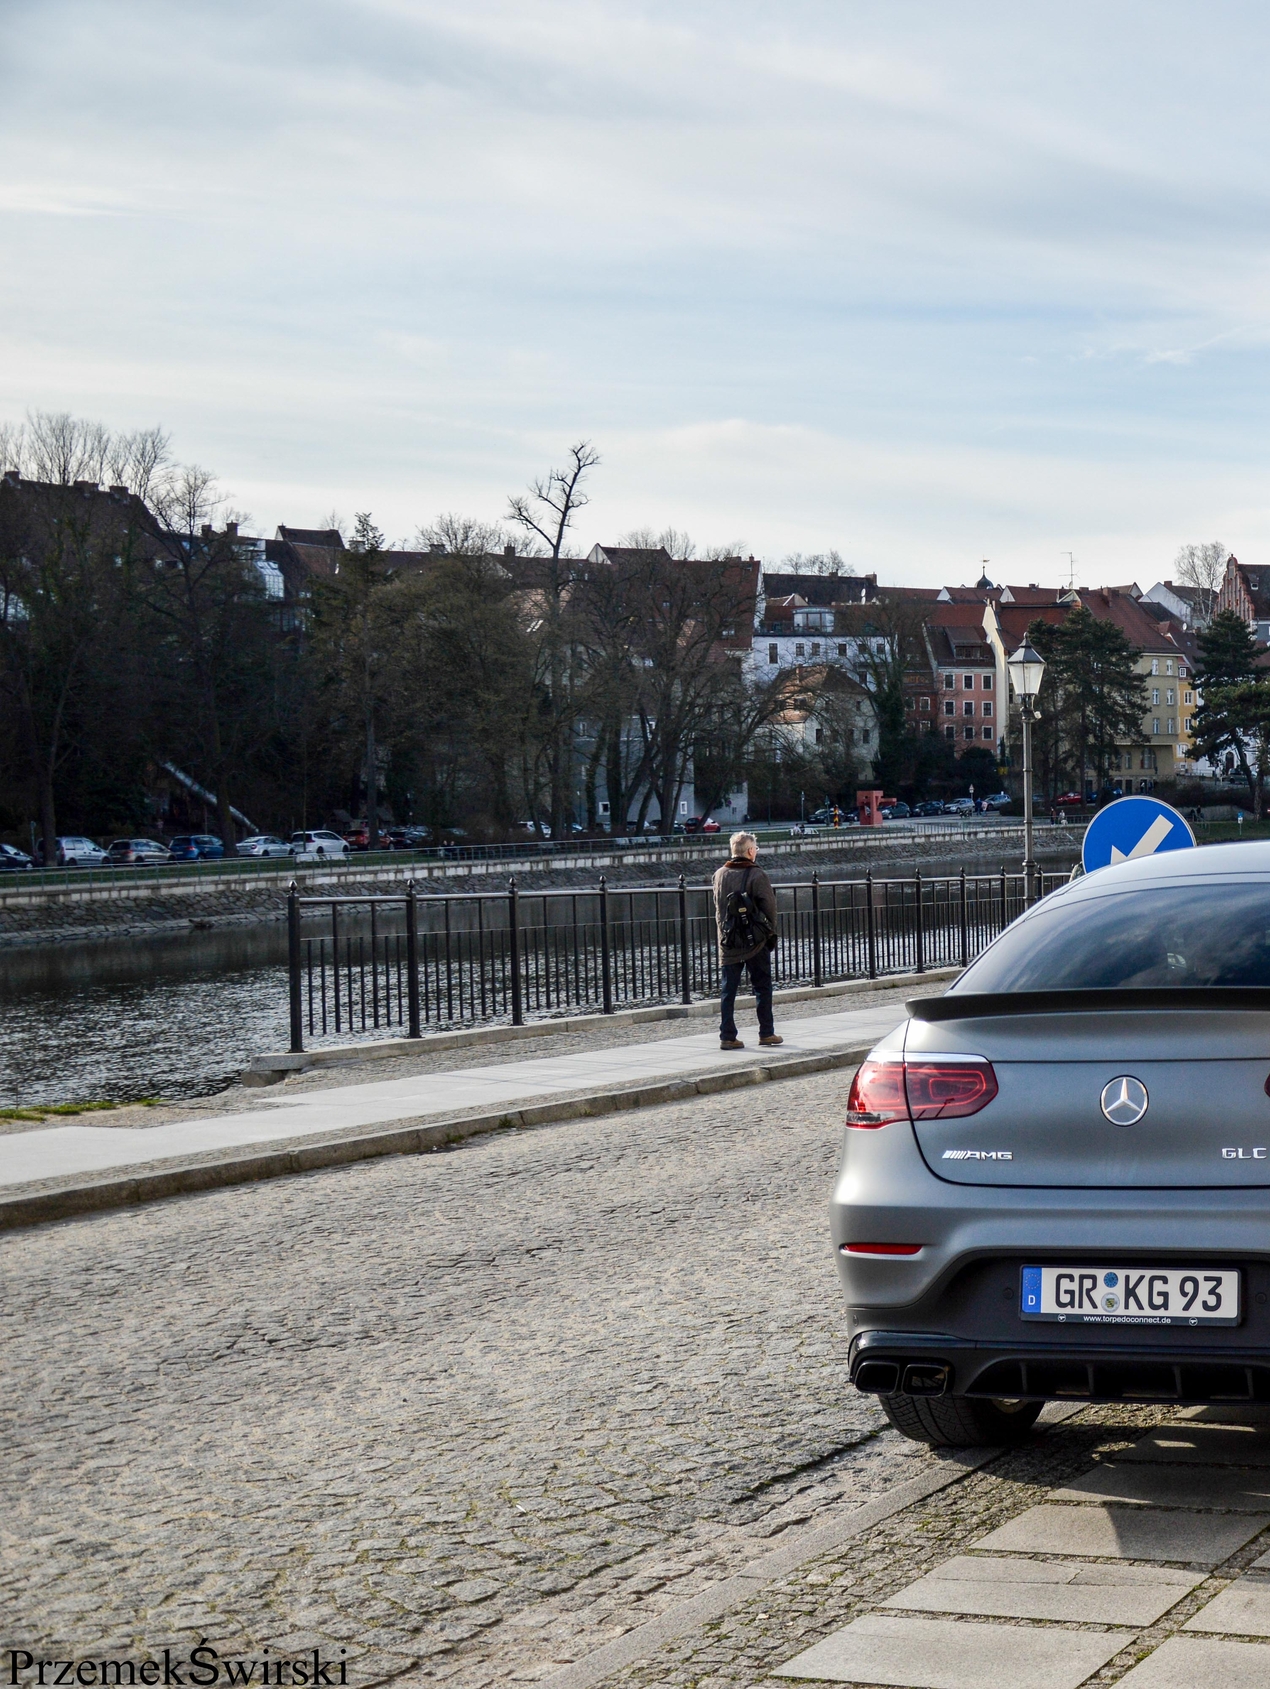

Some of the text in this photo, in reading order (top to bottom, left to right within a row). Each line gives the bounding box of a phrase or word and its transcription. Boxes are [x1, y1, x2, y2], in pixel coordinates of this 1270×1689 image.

[964, 1151, 1013, 1160] AMG
[1222, 1147, 1267, 1159] GLC
[1055, 1273, 1223, 1312] GR KG 93
[1028, 1295, 1036, 1306] D
[1083, 1315, 1171, 1324] www.torpedoconnect.de
